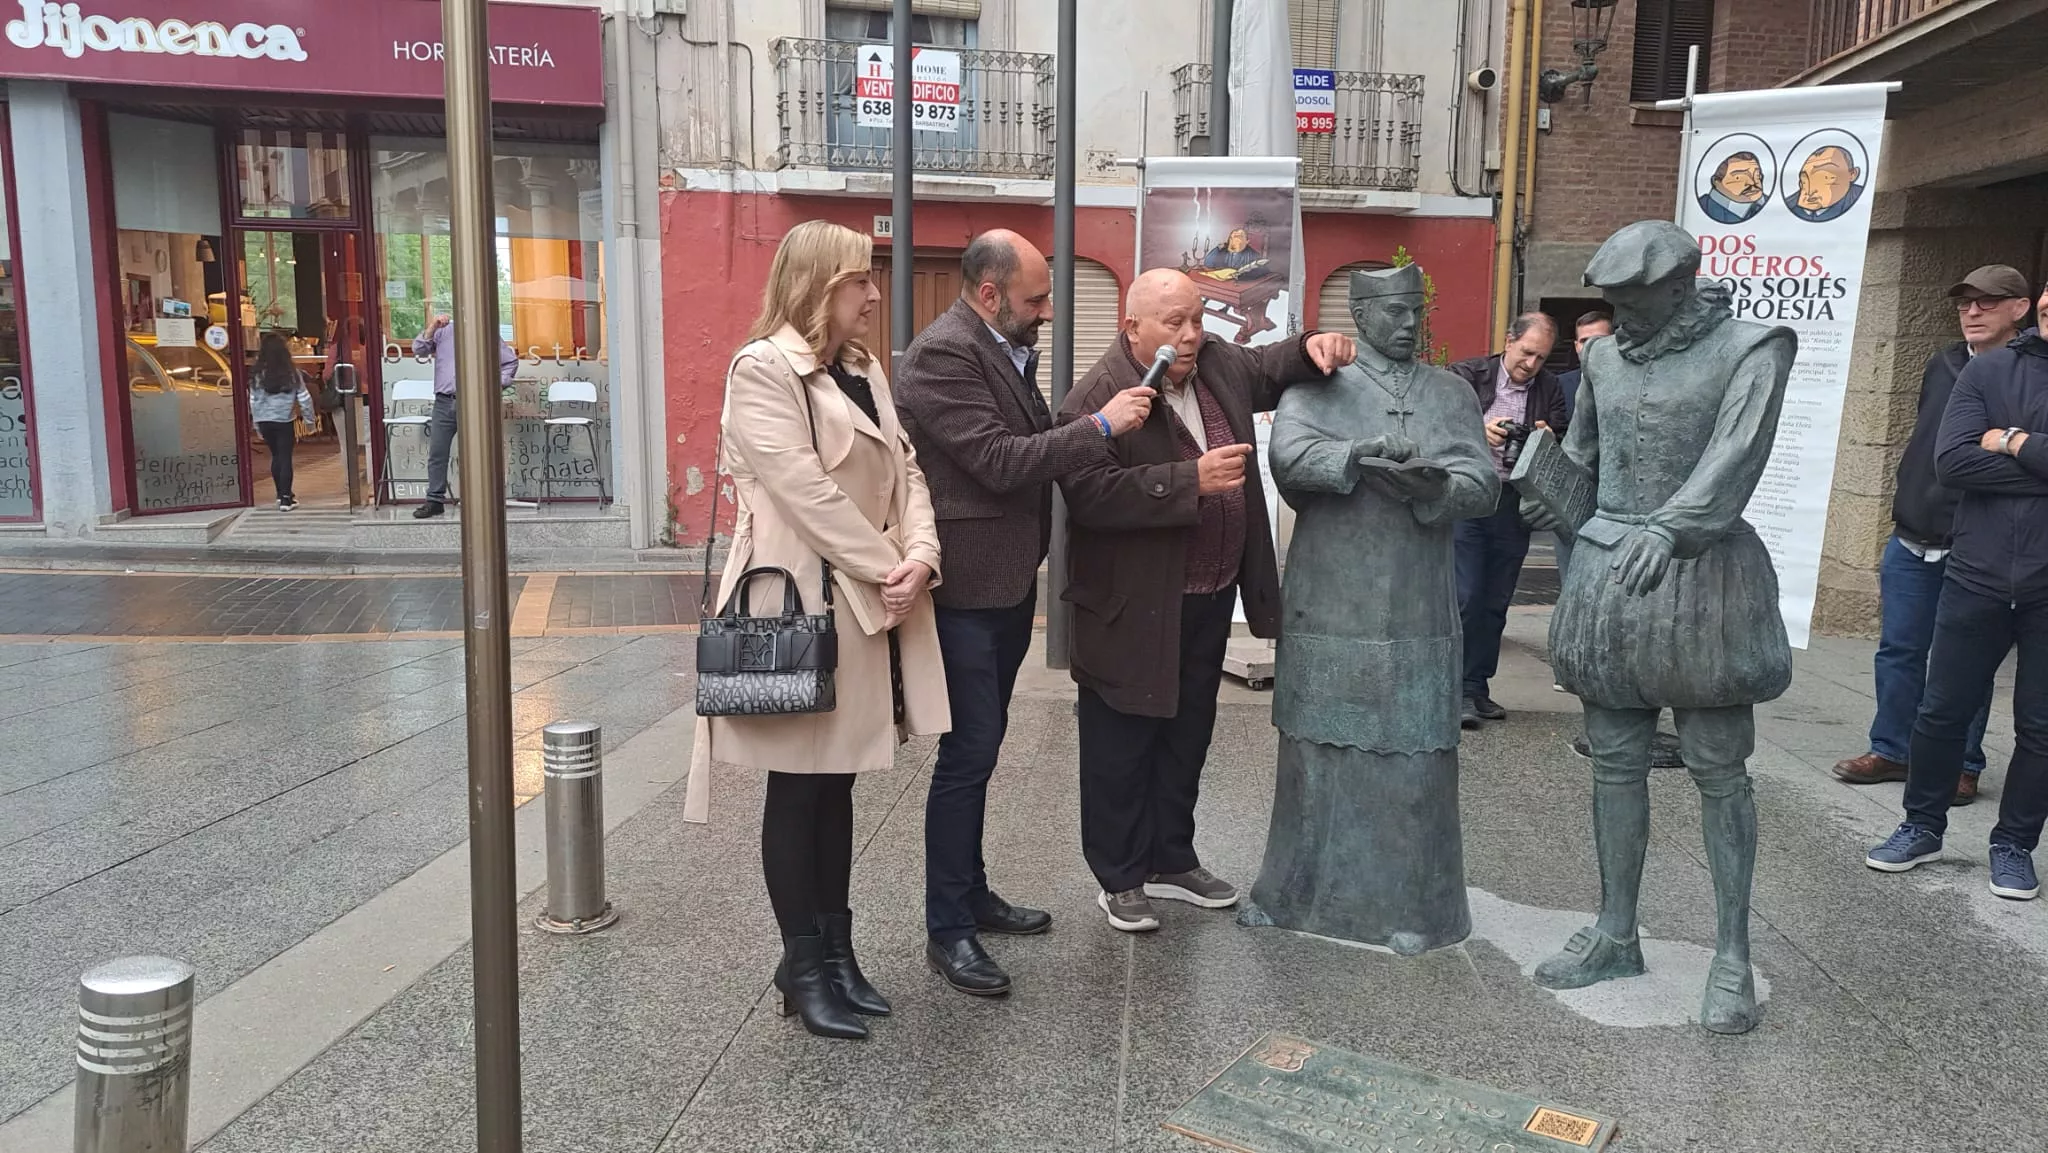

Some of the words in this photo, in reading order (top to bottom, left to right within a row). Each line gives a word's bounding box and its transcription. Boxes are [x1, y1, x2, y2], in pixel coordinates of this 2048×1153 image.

[5, 0, 308, 61] Jijonenca
[393, 41, 556, 68] HORATERÍA
[863, 80, 894, 97] VENT
[913, 84, 956, 101] DIFICIO
[1293, 75, 1330, 87] ENDE
[862, 100, 892, 116] 638
[928, 105, 956, 120] 873
[1295, 96, 1332, 106] DOSOL
[1311, 117, 1333, 129] 995
[877, 220, 890, 232] 38
[1698, 234, 1757, 256] DOS
[1718, 277, 1753, 298] OS
